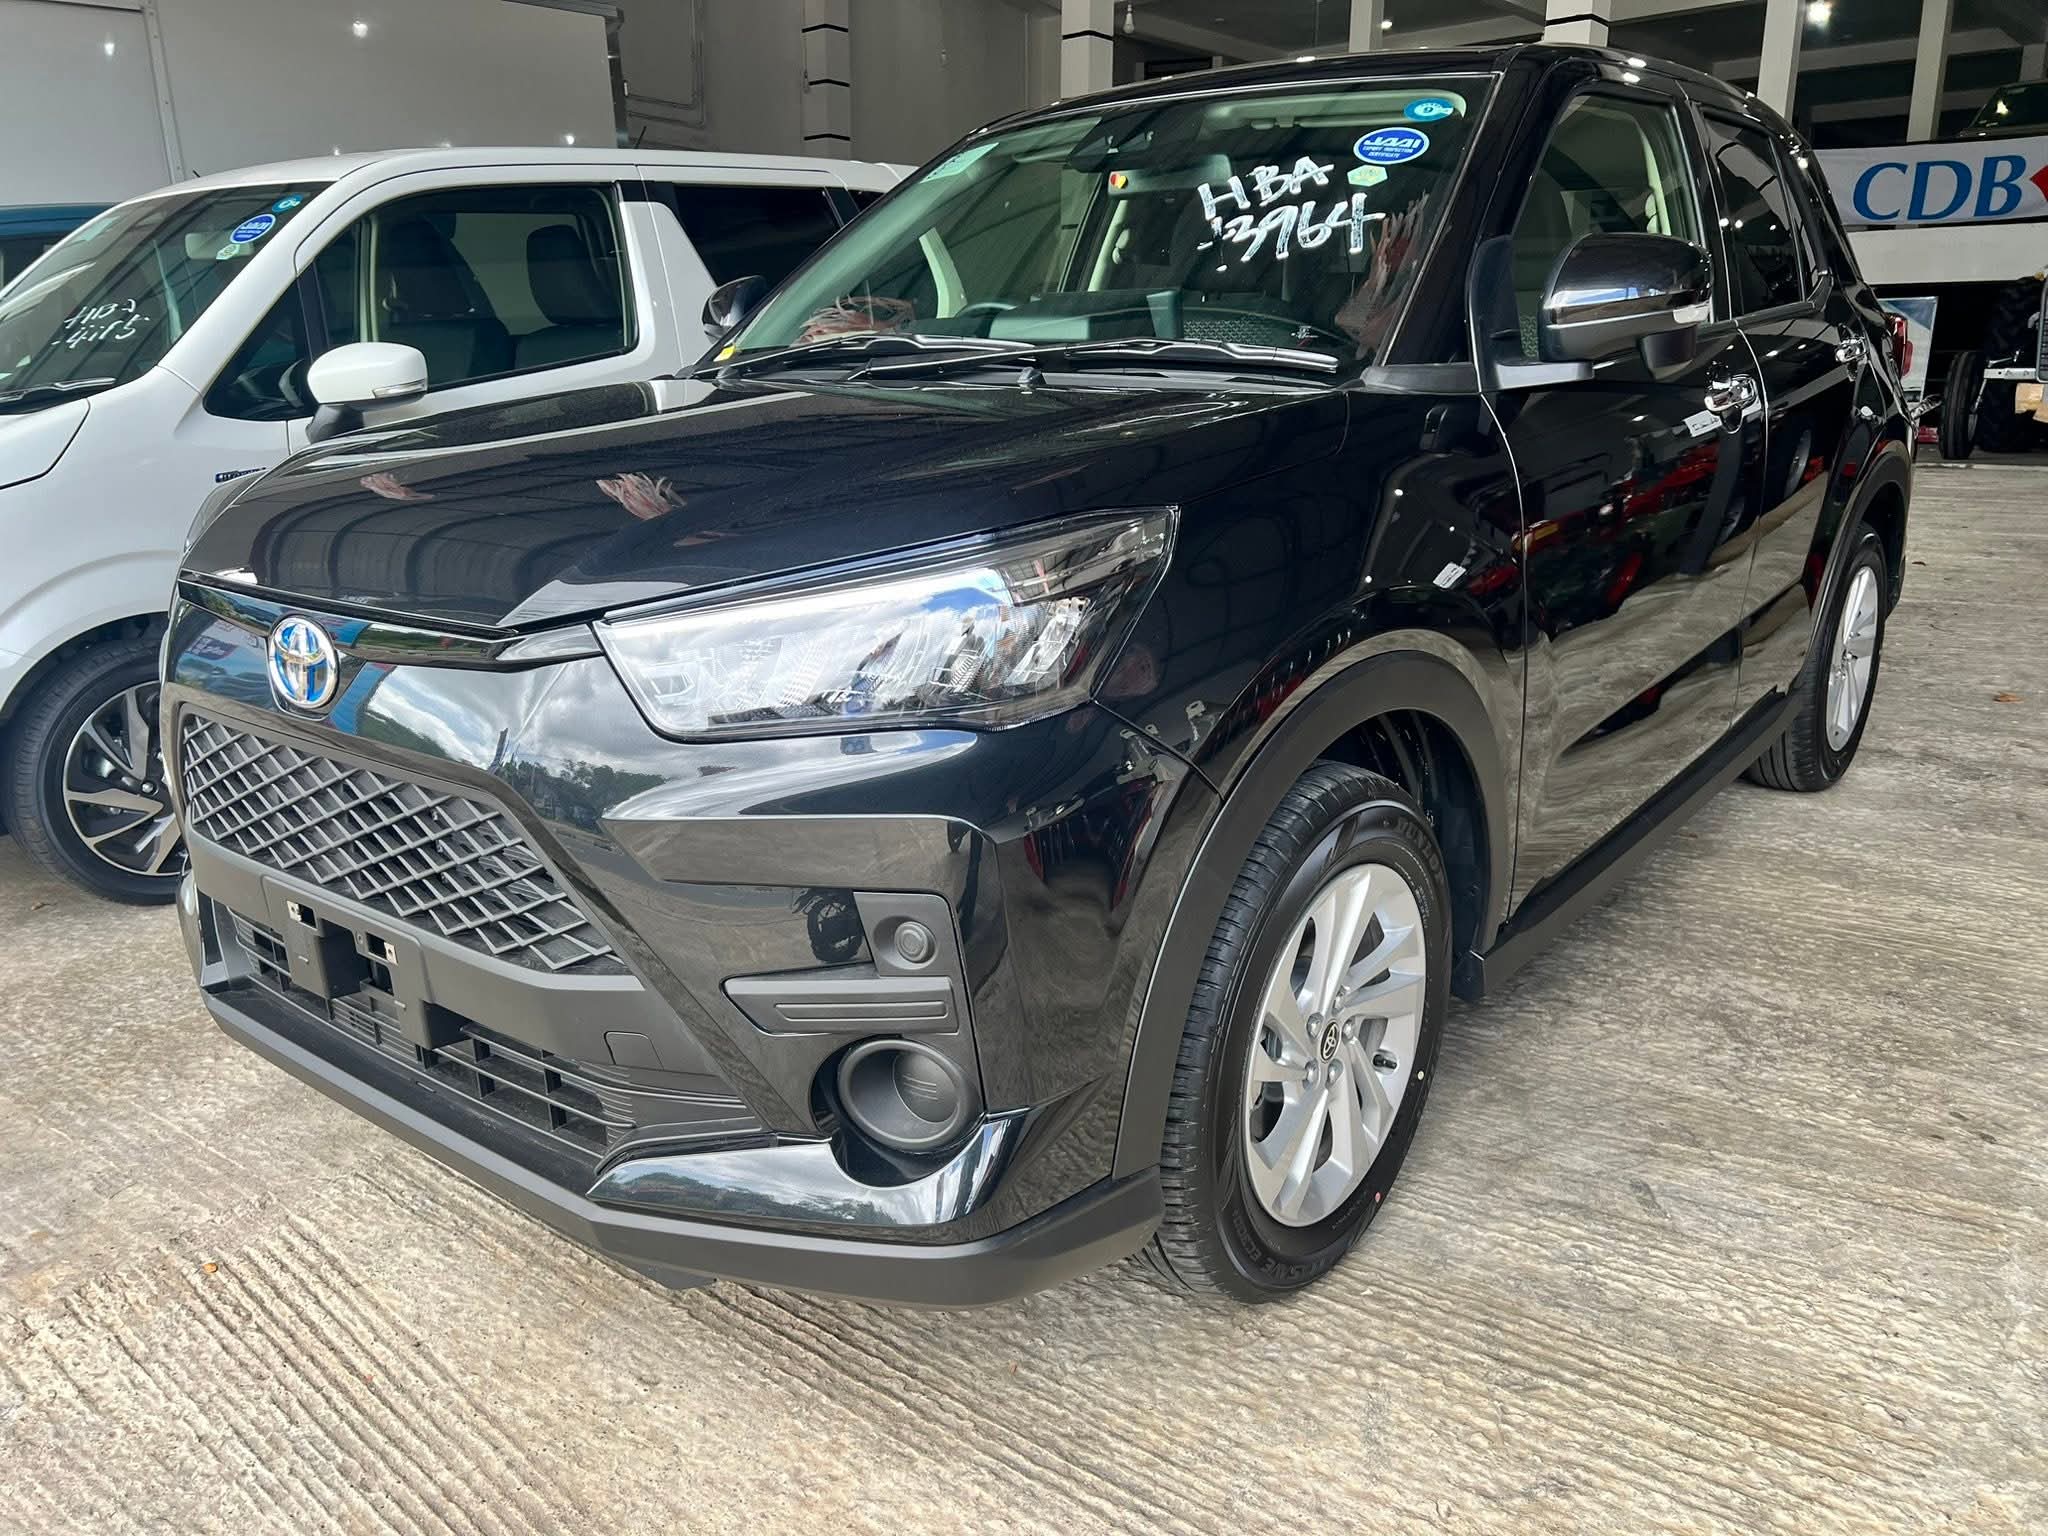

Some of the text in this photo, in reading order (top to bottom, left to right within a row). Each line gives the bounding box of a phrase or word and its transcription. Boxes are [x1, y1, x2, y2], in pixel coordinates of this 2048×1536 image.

[1363, 136, 1422, 149] JAAI
[1197, 156, 1335, 221] HBA
[1853, 155, 2027, 221] CDB
